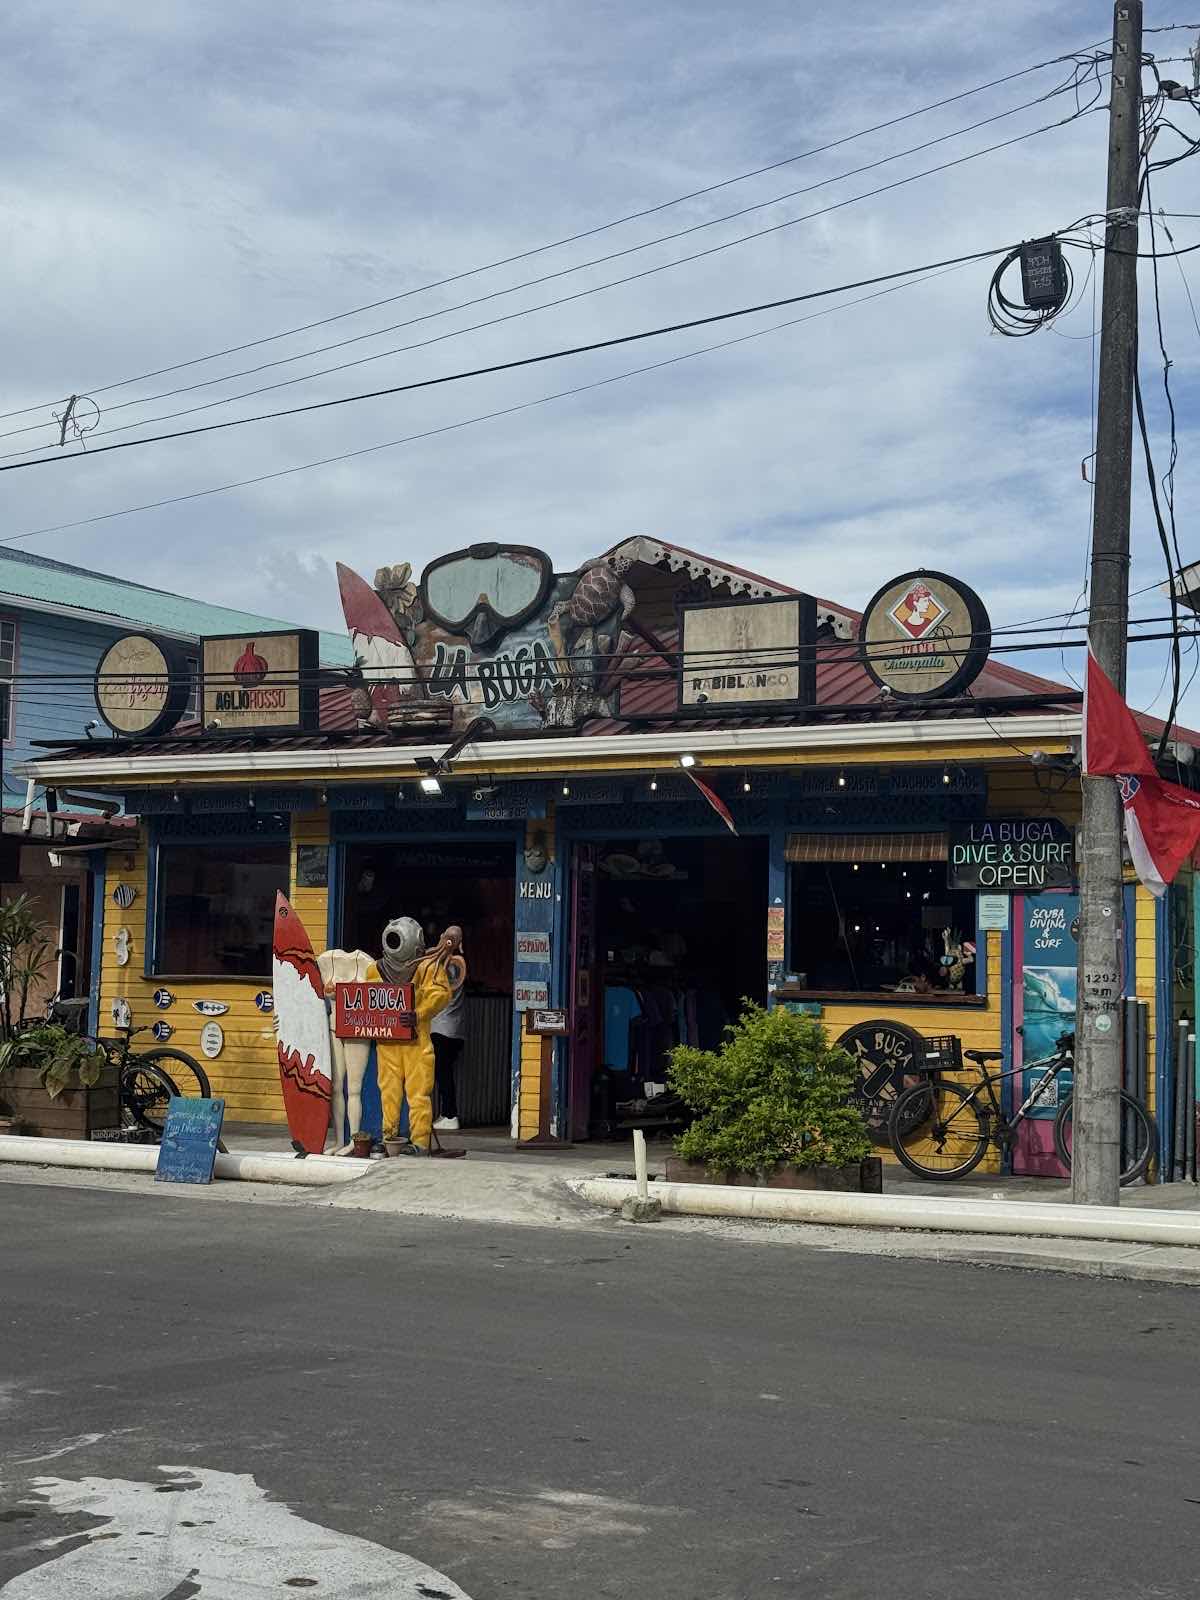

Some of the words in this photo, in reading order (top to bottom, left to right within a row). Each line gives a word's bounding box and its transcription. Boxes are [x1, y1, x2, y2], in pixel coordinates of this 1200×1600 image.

[428, 642, 471, 703] LA
[478, 640, 560, 713] BUGA
[692, 674, 789, 690] RABIBLANCO
[970, 823, 995, 842] LA
[1000, 823, 1054, 841] BUGA
[953, 844, 998, 864] DIVE
[1002, 843, 1021, 863] &
[1020, 843, 1072, 862] SURF
[980, 865, 1045, 886] OPEN
[519, 882, 551, 898] MENU
[1033, 908, 1065, 919] SCUBA
[1030, 918, 1066, 930] DIVING
[1034, 938, 1063, 949] SURF
[343, 987, 364, 1010] LA
[368, 987, 406, 1010] BUGA
[354, 1027, 393, 1037] PANAMA
